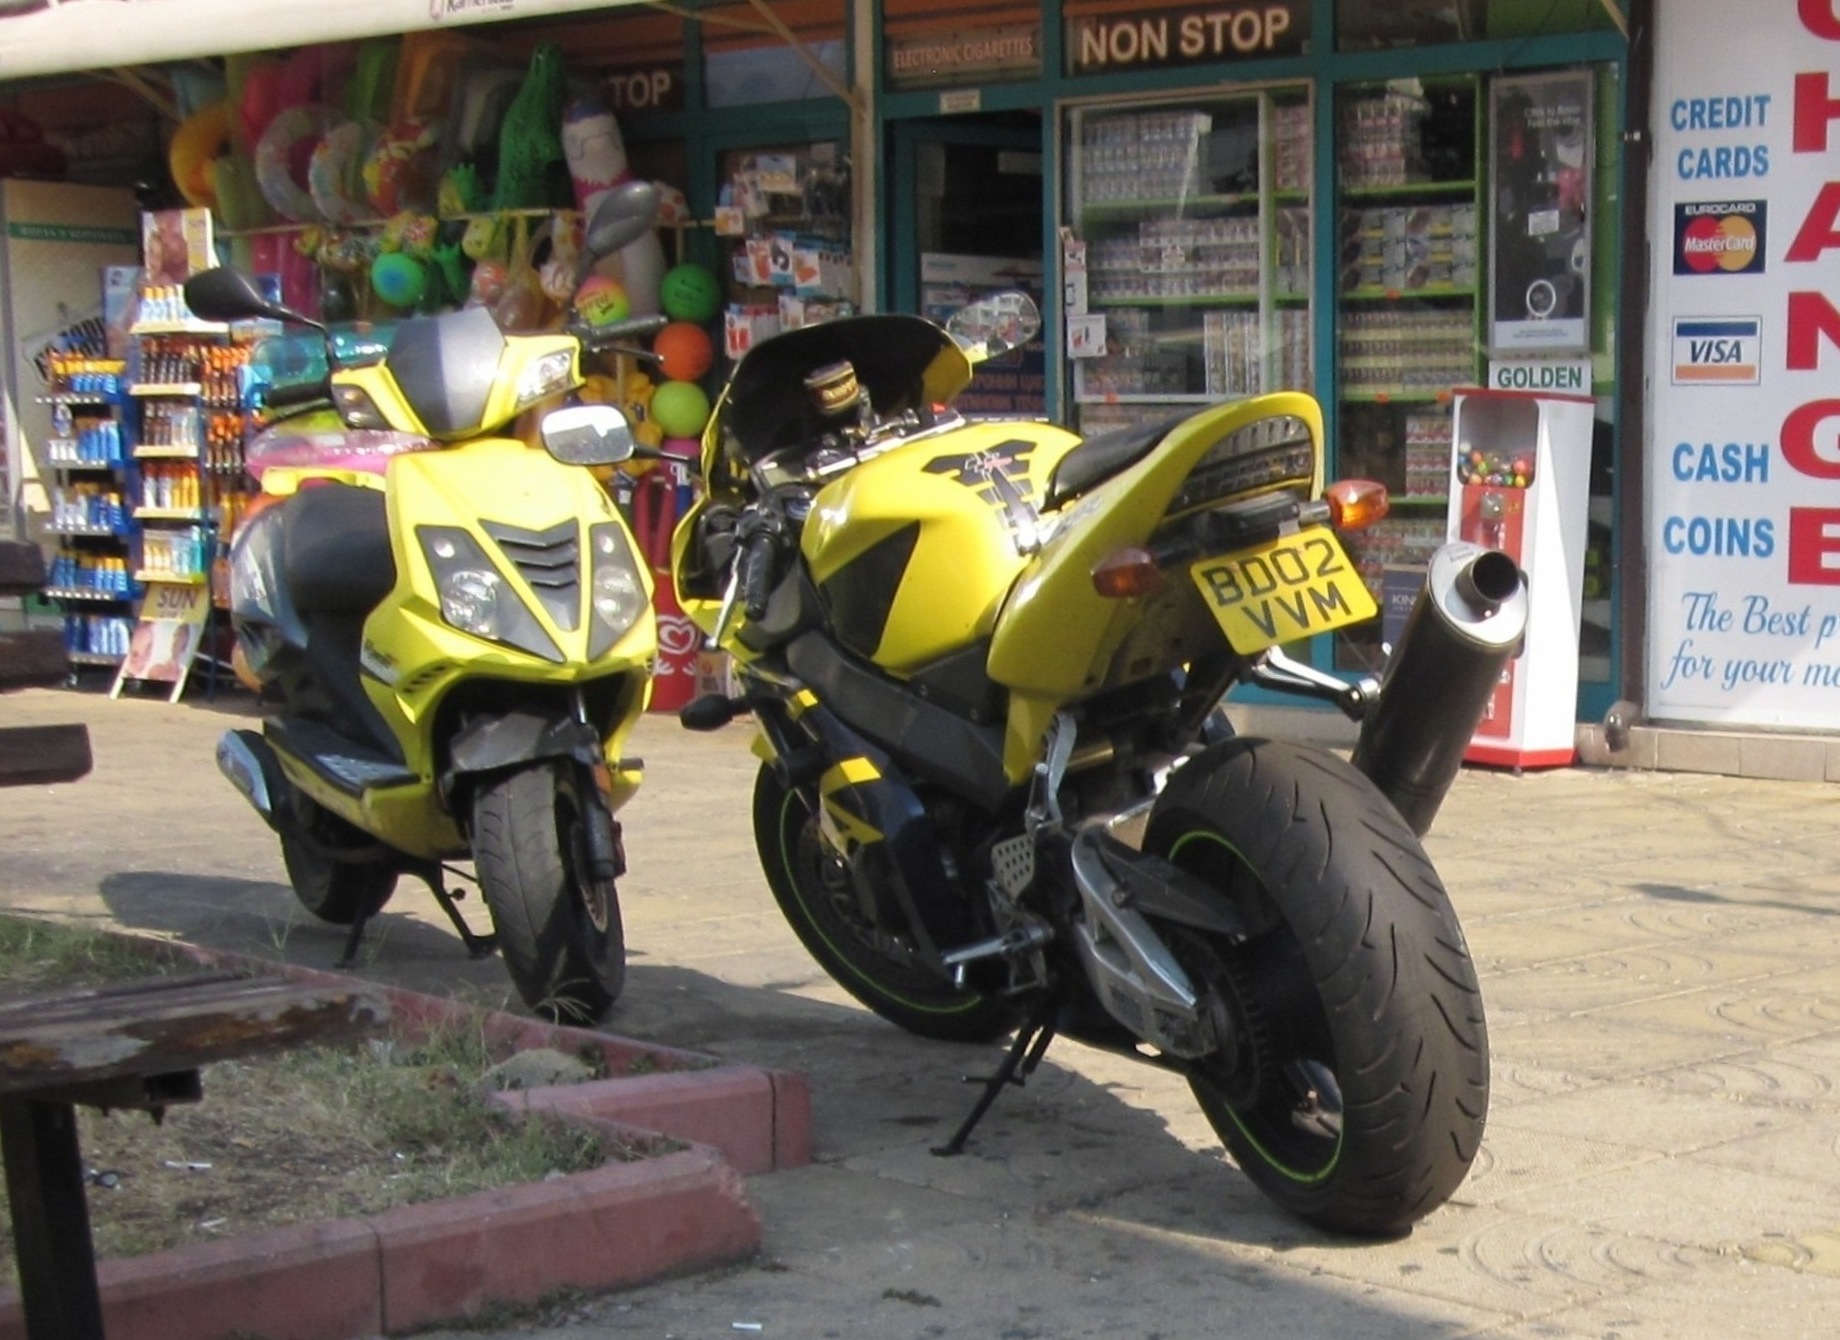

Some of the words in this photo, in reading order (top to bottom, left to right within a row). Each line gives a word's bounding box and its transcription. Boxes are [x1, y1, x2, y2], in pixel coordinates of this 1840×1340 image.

[894, 43, 961, 69] ELECTRONIC
[962, 37, 1033, 62] CIGARETTES
[1081, 19, 1168, 65] NON
[1180, 8, 1290, 57] STOP
[1671, 95, 1771, 131] CREDIT
[1678, 145, 1769, 179] CARDS
[1684, 202, 1756, 216] EUROCARD
[1684, 235, 1757, 253] MasterCard
[1690, 339, 1742, 363] VISA
[1498, 366, 1582, 389] GOLDEN
[1672, 442, 1769, 483] CASH
[1663, 515, 1775, 558] COINS
[157, 585, 198, 610] SUN
[1240, 580, 1353, 639] VVM
[1681, 591, 1733, 632] The
[1743, 594, 1811, 636] Best
[1815, 612, 1840, 650] p
[1660, 638, 1714, 690] for
[1721, 658, 1792, 692] your
